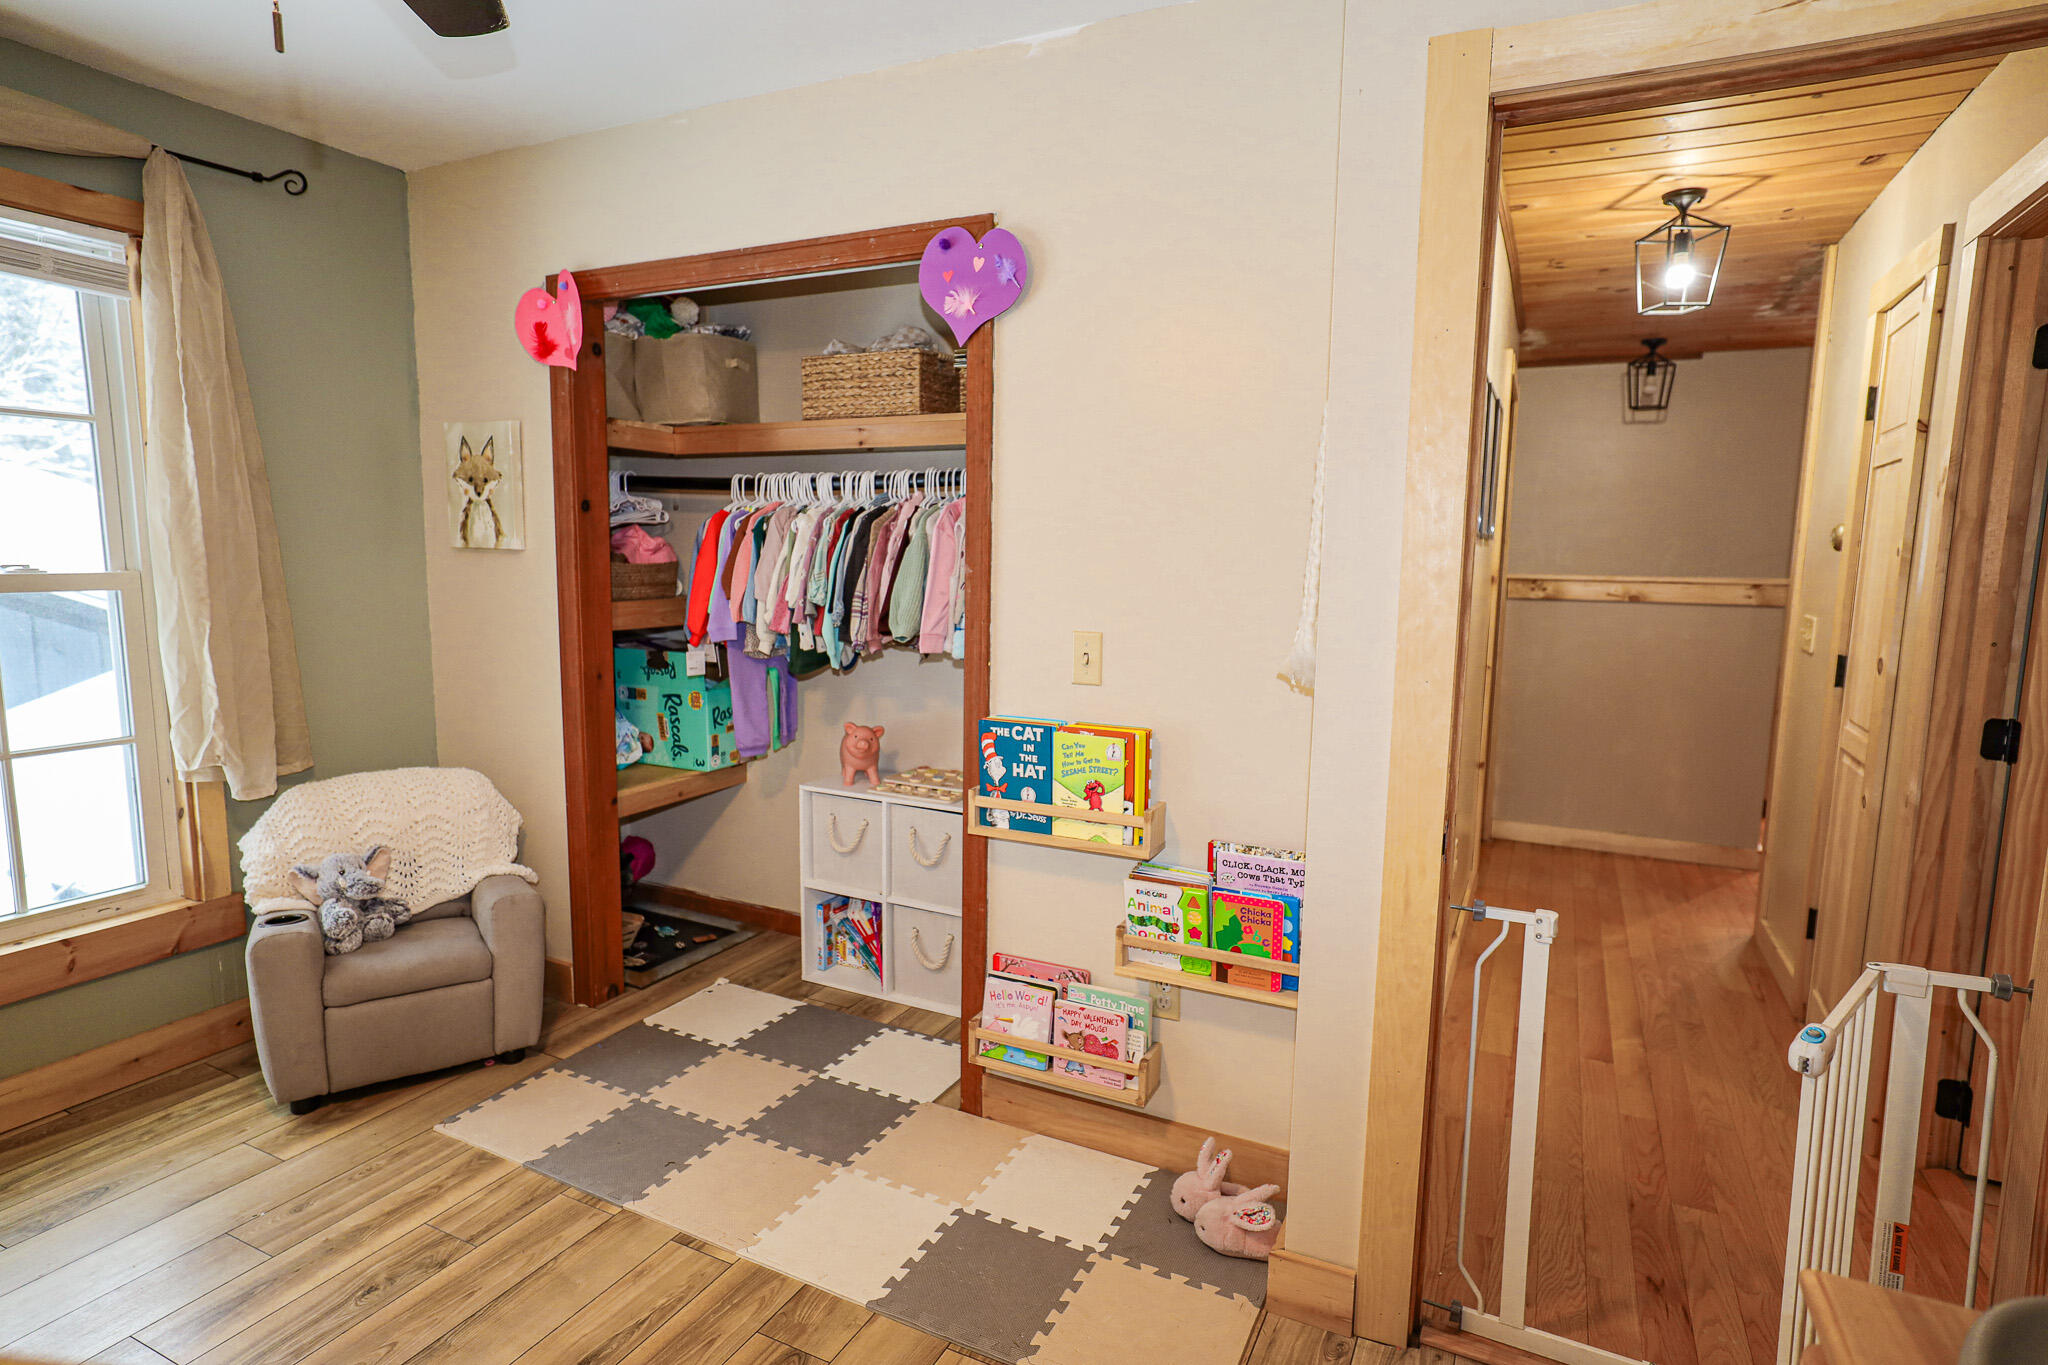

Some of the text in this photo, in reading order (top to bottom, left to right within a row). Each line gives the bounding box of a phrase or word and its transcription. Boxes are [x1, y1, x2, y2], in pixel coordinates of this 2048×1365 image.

[990, 725, 1044, 742] THE CAT
[1023, 743, 1034, 752] IN
[696, 759, 705, 767] 3
[1018, 753, 1038, 763] THE
[1062, 760, 1074, 768] How
[1012, 762, 1047, 780] HAT
[1061, 765, 1119, 778] SESAME STREET?
[1027, 813, 1047, 823] Seuss
[1222, 859, 1253, 871] CLICK,
[1254, 863, 1289, 876] CLACK,
[1237, 871, 1261, 882] Cows
[1263, 874, 1286, 885] That
[1127, 896, 1175, 917] Animal
[1240, 906, 1272, 918] Chicka
[1240, 915, 1272, 926] Chicka
[989, 990, 1049, 1006] Hello World!
[1119, 1000, 1145, 1015] Time
[1062, 1009, 1081, 1019] HAPPY
[1085, 1023, 1108, 1033] MOUSE!
